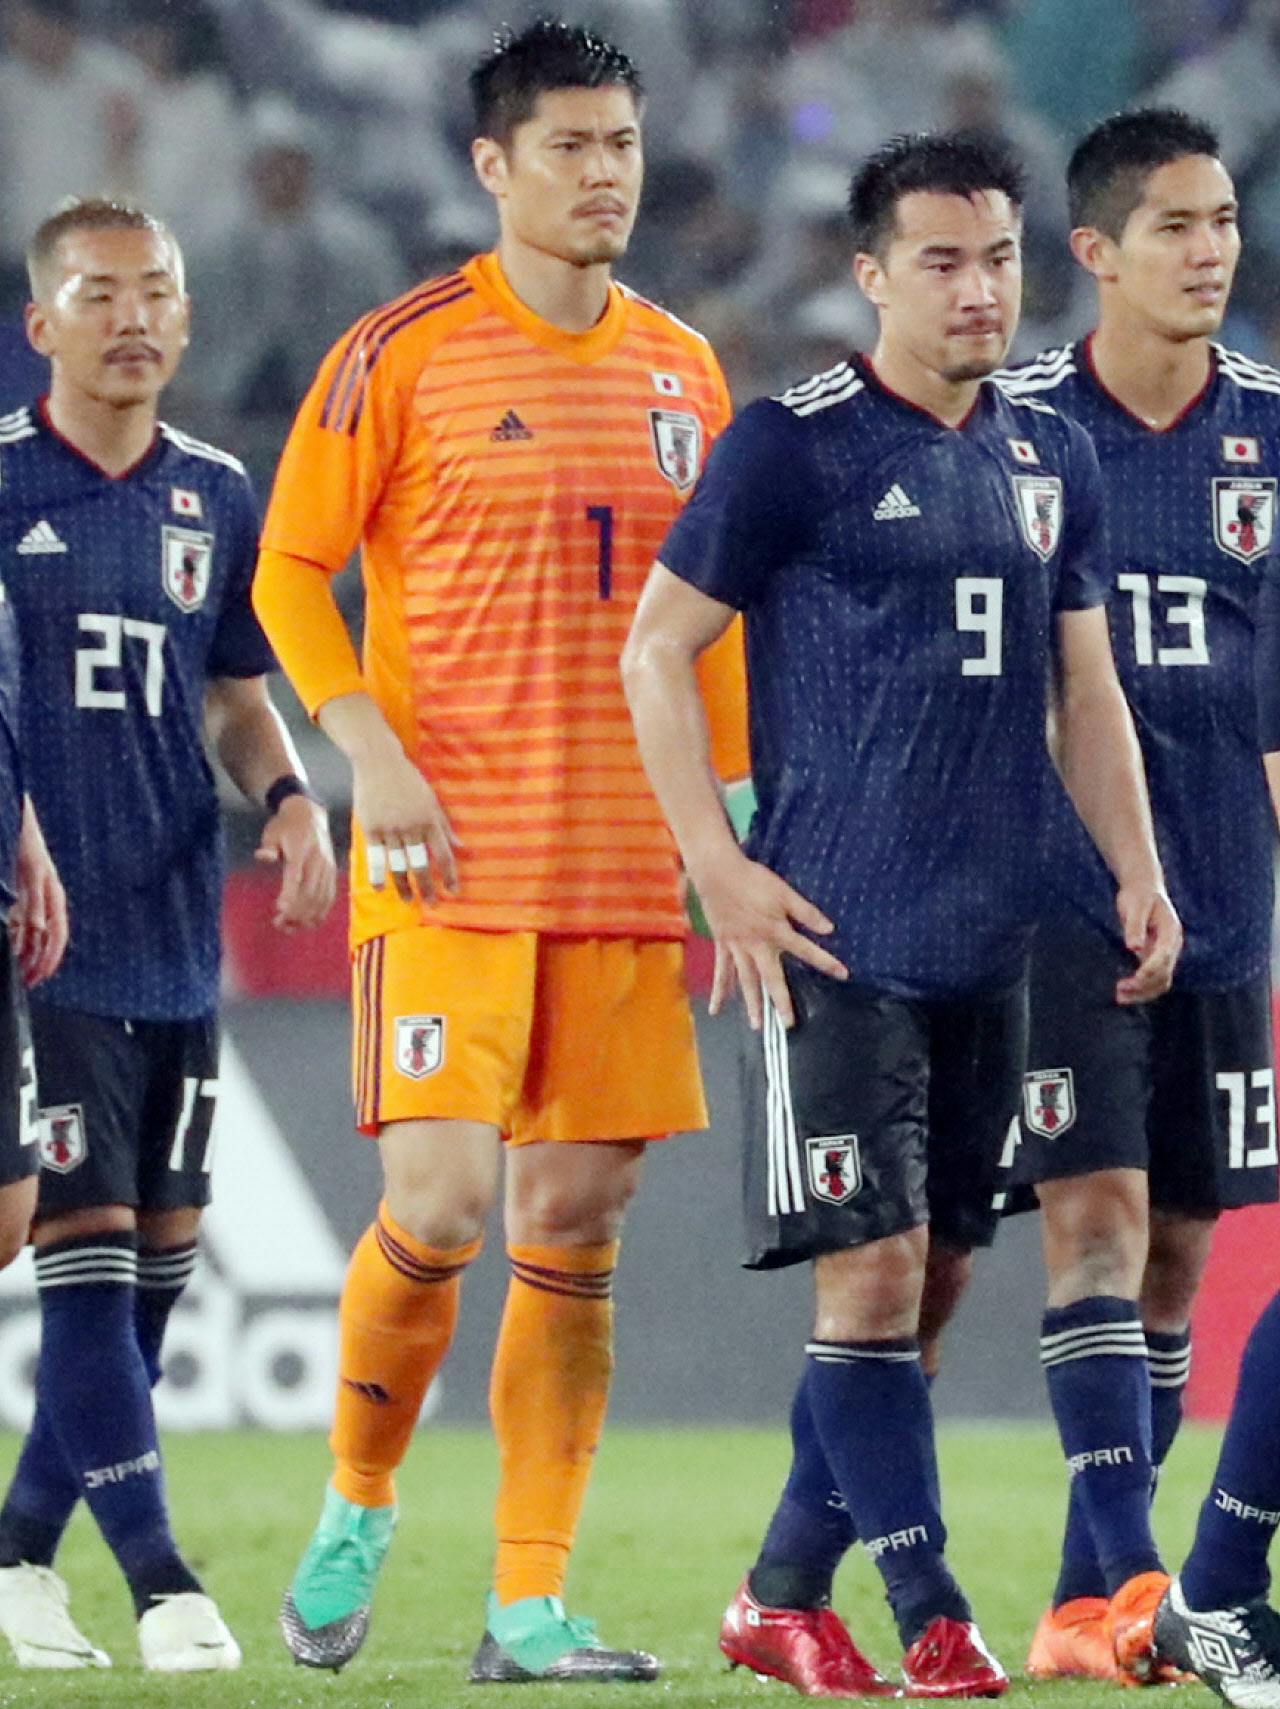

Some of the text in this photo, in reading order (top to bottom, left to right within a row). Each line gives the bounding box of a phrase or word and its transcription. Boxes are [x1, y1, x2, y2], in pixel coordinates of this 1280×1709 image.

[586, 506, 611, 600] 1
[873, 505, 921, 521] adidas
[75, 613, 167, 717] 27
[955, 577, 1003, 676] 9
[1117, 572, 1211, 667] 13
[1215, 1068, 1279, 1169] 13
